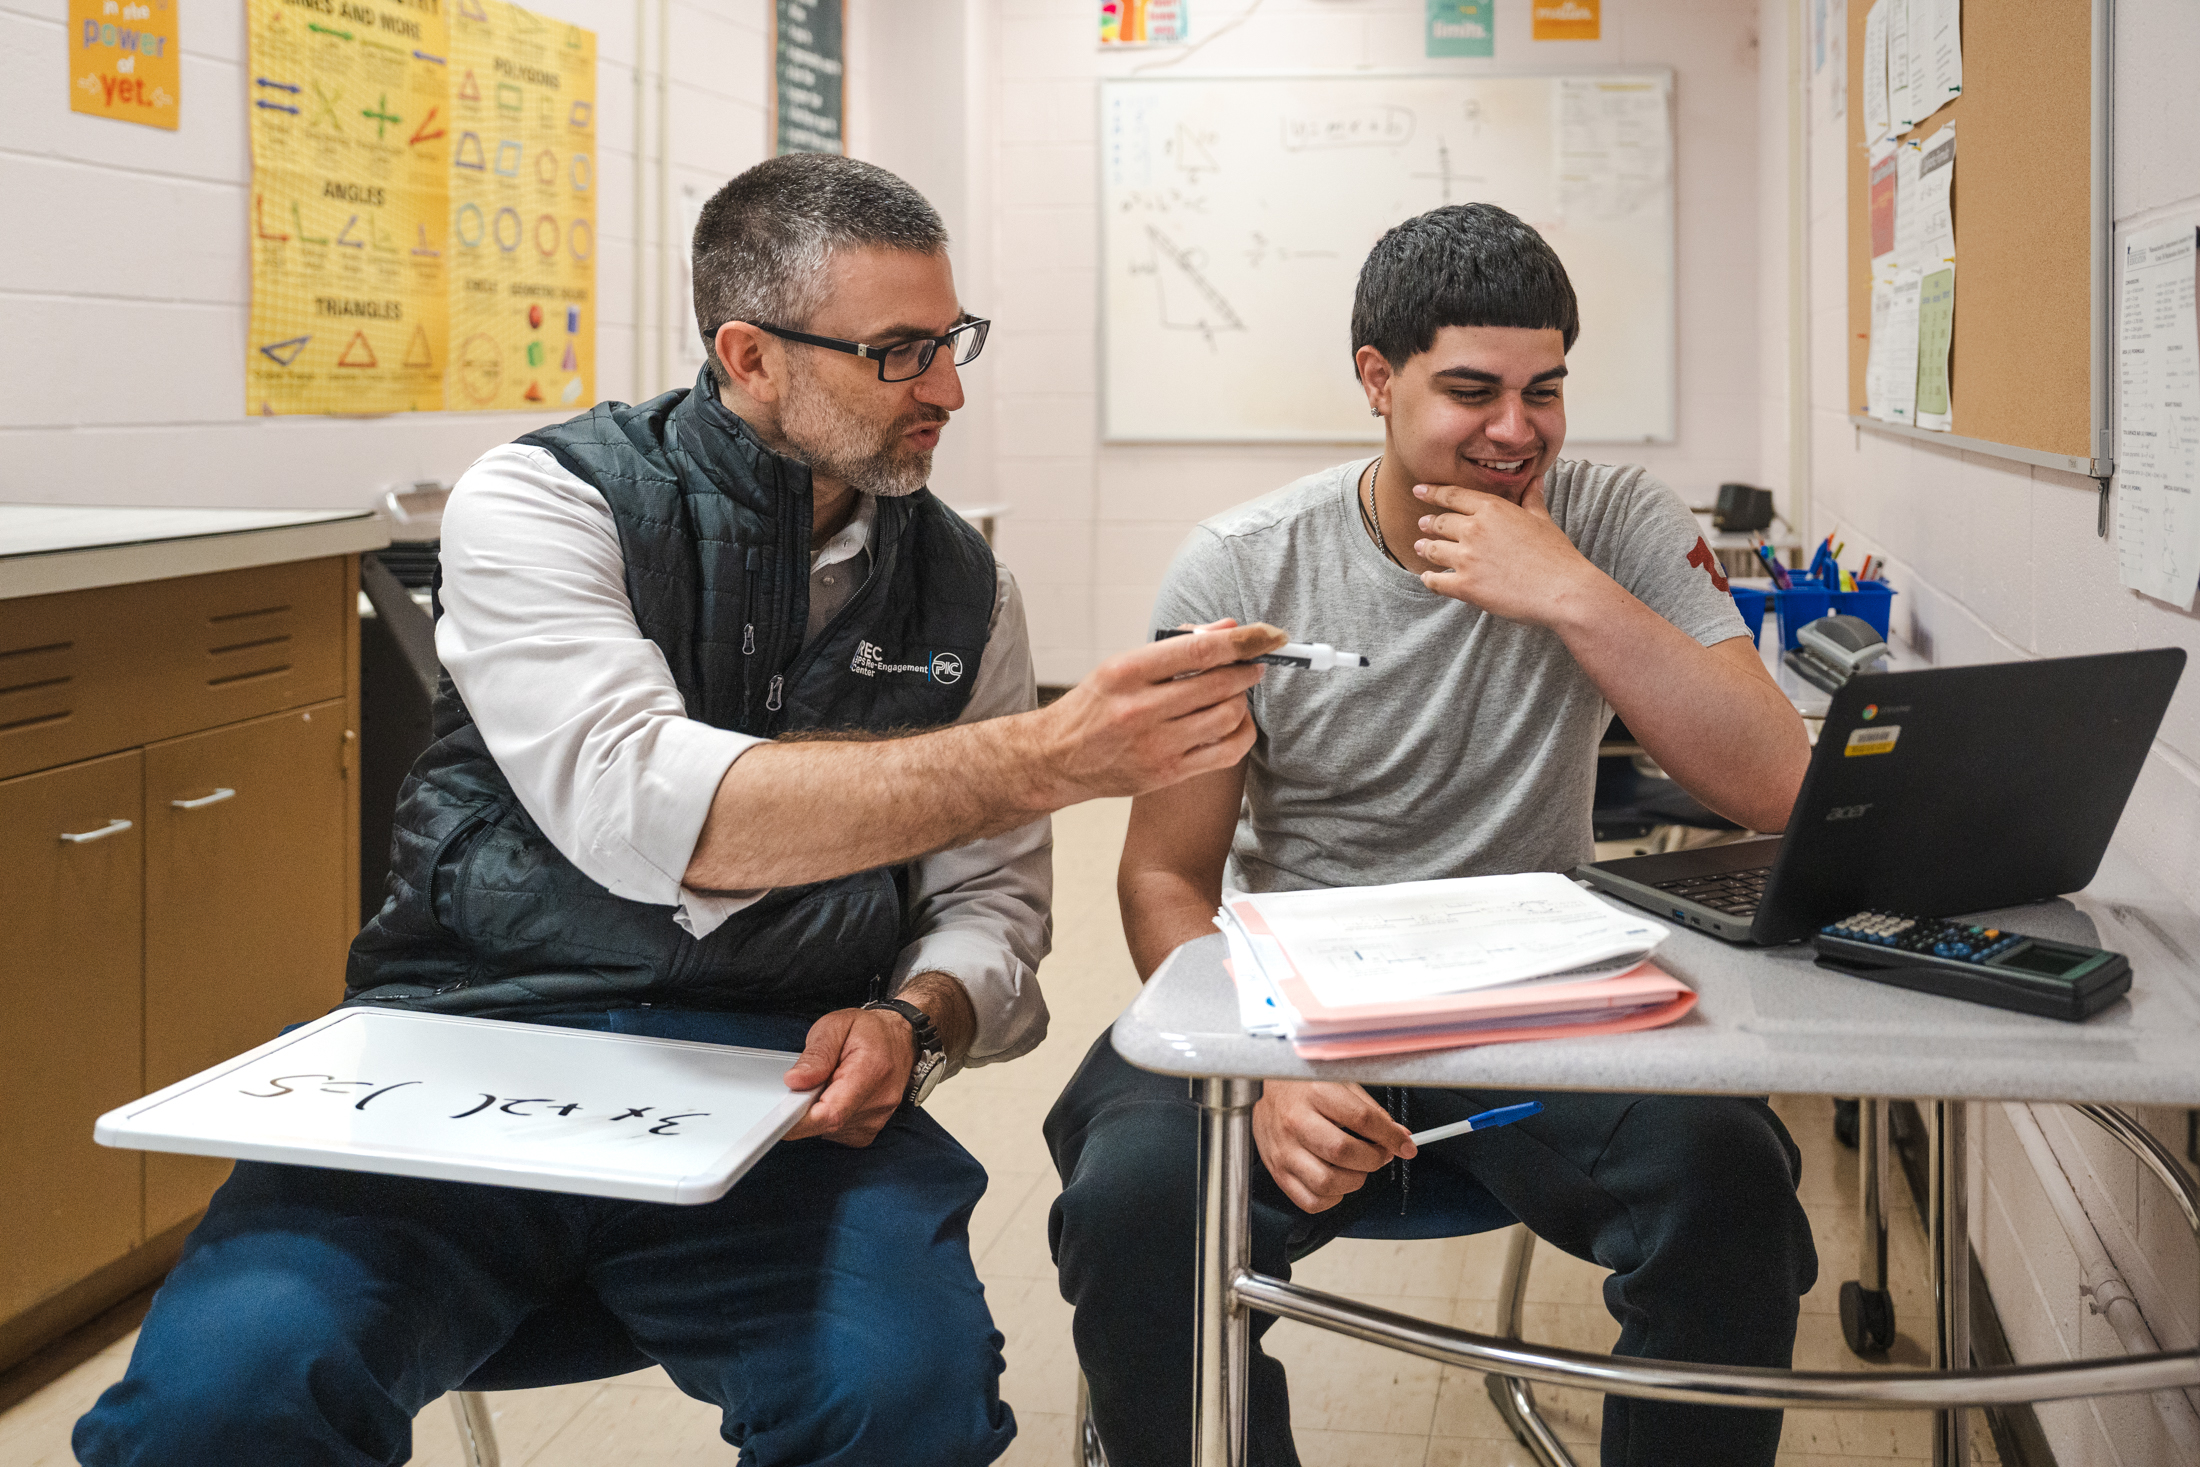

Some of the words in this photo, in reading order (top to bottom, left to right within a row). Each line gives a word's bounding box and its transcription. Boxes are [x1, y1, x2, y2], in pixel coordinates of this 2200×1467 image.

[339, 1, 376, 27] AND
[380, 13, 421, 41] MORE
[83, 18, 167, 58] power
[117, 55, 135, 73] of
[494, 56, 561, 91] POLYGONS
[100, 73, 154, 107] yet.
[323, 179, 386, 206] ANGLES
[315, 297, 403, 321] TRIANGLES
[851, 664, 876, 678] Center
[866, 658, 929, 675] Re-Engagement
[1826, 803, 1874, 821] acer
